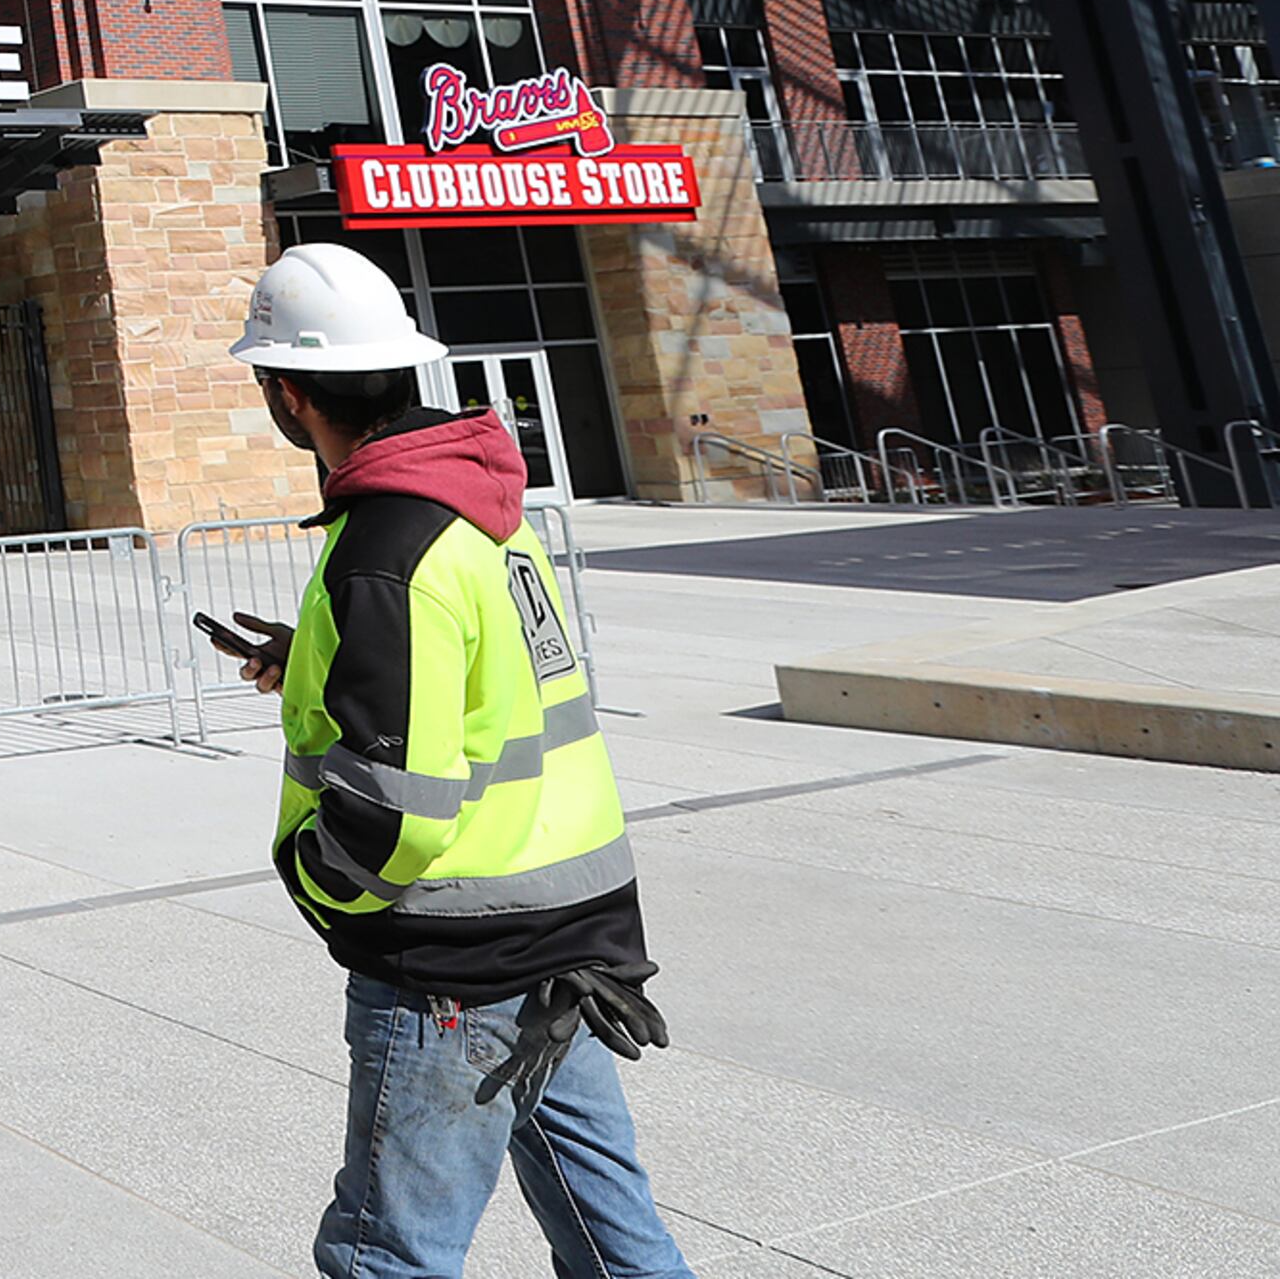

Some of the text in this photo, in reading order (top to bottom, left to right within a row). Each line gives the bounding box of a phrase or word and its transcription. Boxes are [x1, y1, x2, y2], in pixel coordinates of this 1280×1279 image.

[424, 63, 574, 152] Braves
[361, 158, 691, 210] CLUBHOUSE STORE
